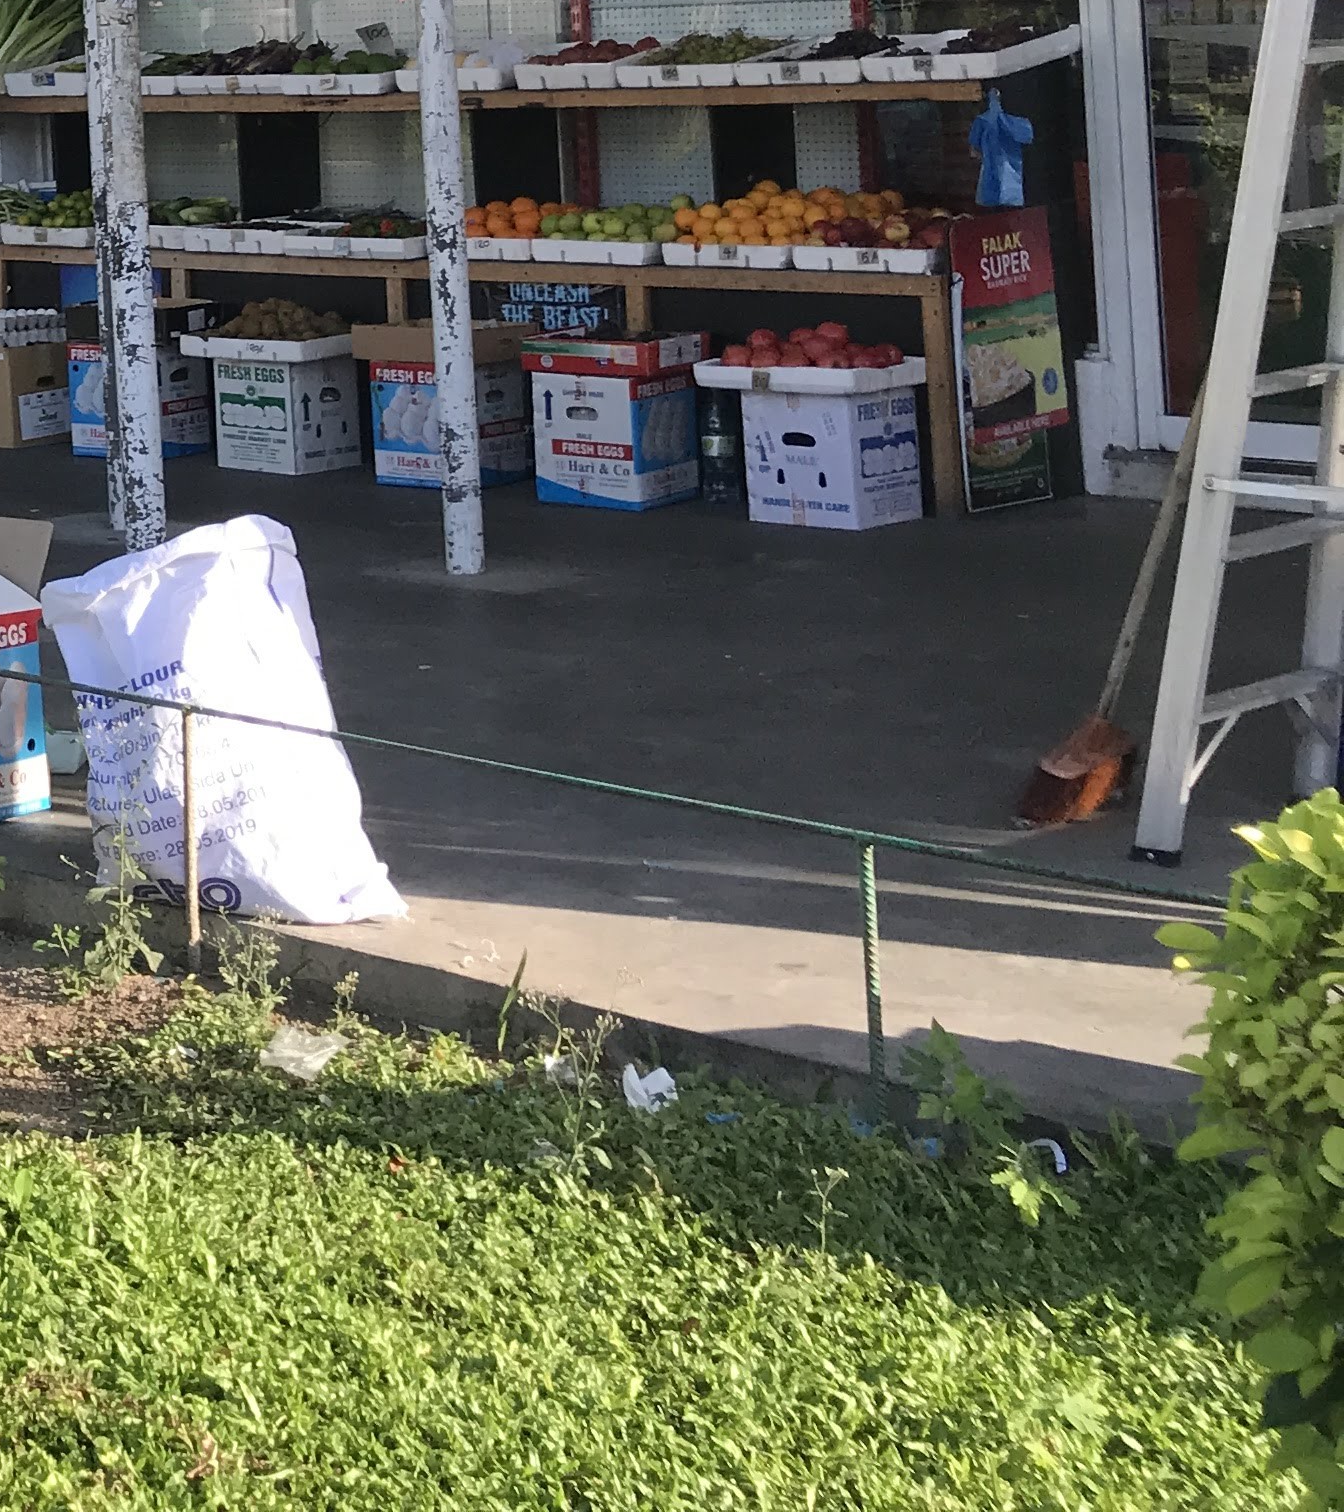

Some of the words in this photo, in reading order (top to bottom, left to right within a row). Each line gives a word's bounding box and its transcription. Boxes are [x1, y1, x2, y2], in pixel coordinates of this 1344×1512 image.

[981, 231, 1023, 255] FALAK
[979, 250, 1032, 281] SUPER
[508, 283, 591, 304] UNLEASH
[501, 304, 534, 324] THE
[542, 305, 610, 332] BEAST!
[217, 363, 252, 382] FRESH
[254, 366, 286, 384] EGGS
[375, 367, 414, 384] FRESH
[561, 442, 595, 456] FRESH
[596, 445, 626, 459] EGGS
[568, 460, 596, 475] Hari
[599, 463, 610, 476] &
[612, 463, 632, 477] Co
[130, 658, 187, 693] LOUR
[169, 685, 192, 701] kg
[9, 768, 28, 786] Co
[137, 813, 183, 837] Date:
